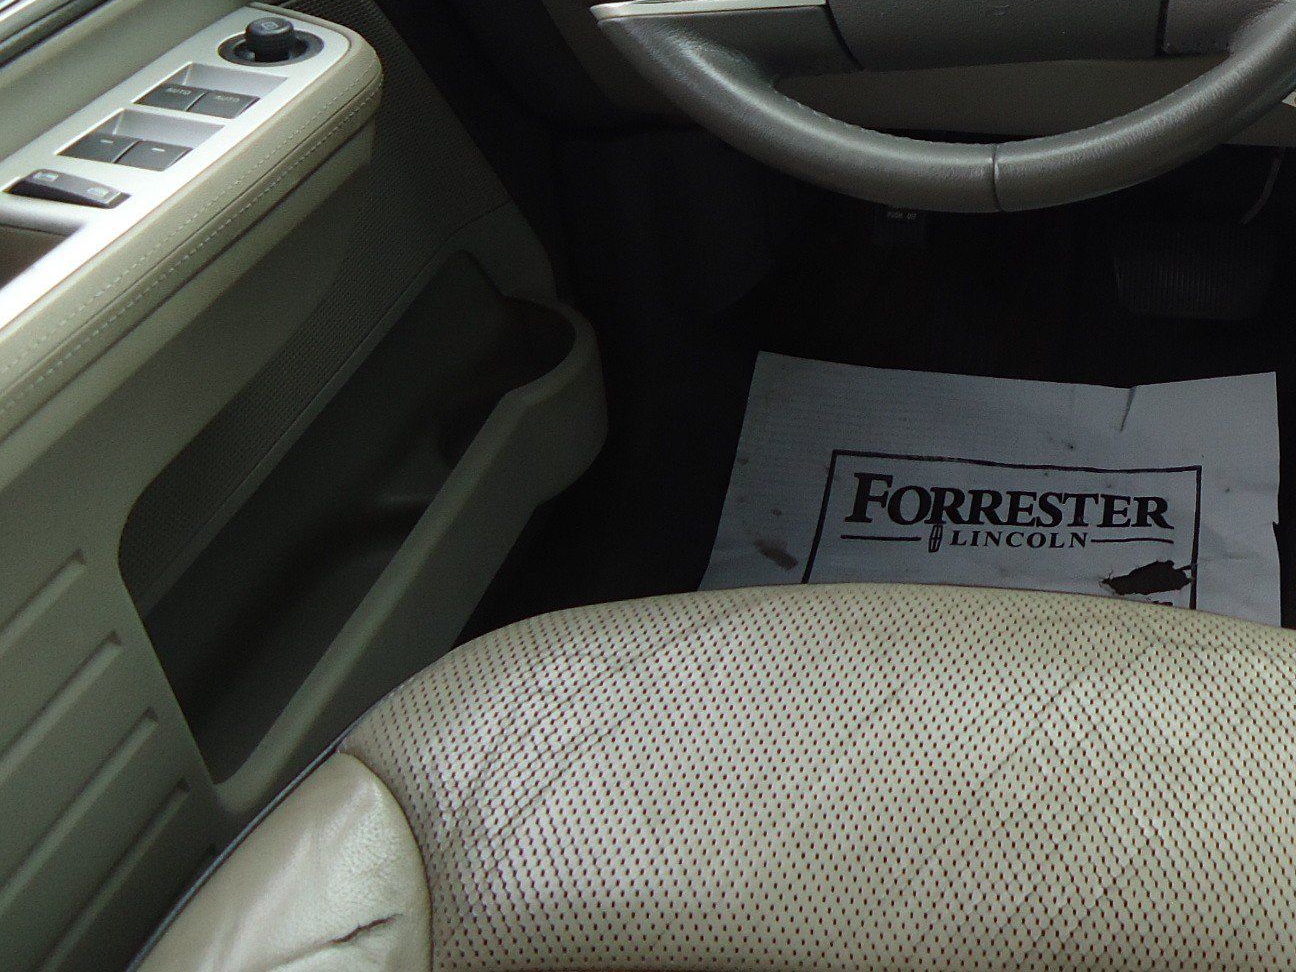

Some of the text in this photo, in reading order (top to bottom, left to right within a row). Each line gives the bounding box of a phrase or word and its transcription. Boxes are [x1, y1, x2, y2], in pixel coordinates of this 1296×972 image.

[214, 94, 240, 103] AUTO
[844, 471, 1175, 530] FORRESTER
[950, 529, 1089, 549] LINCOLN
